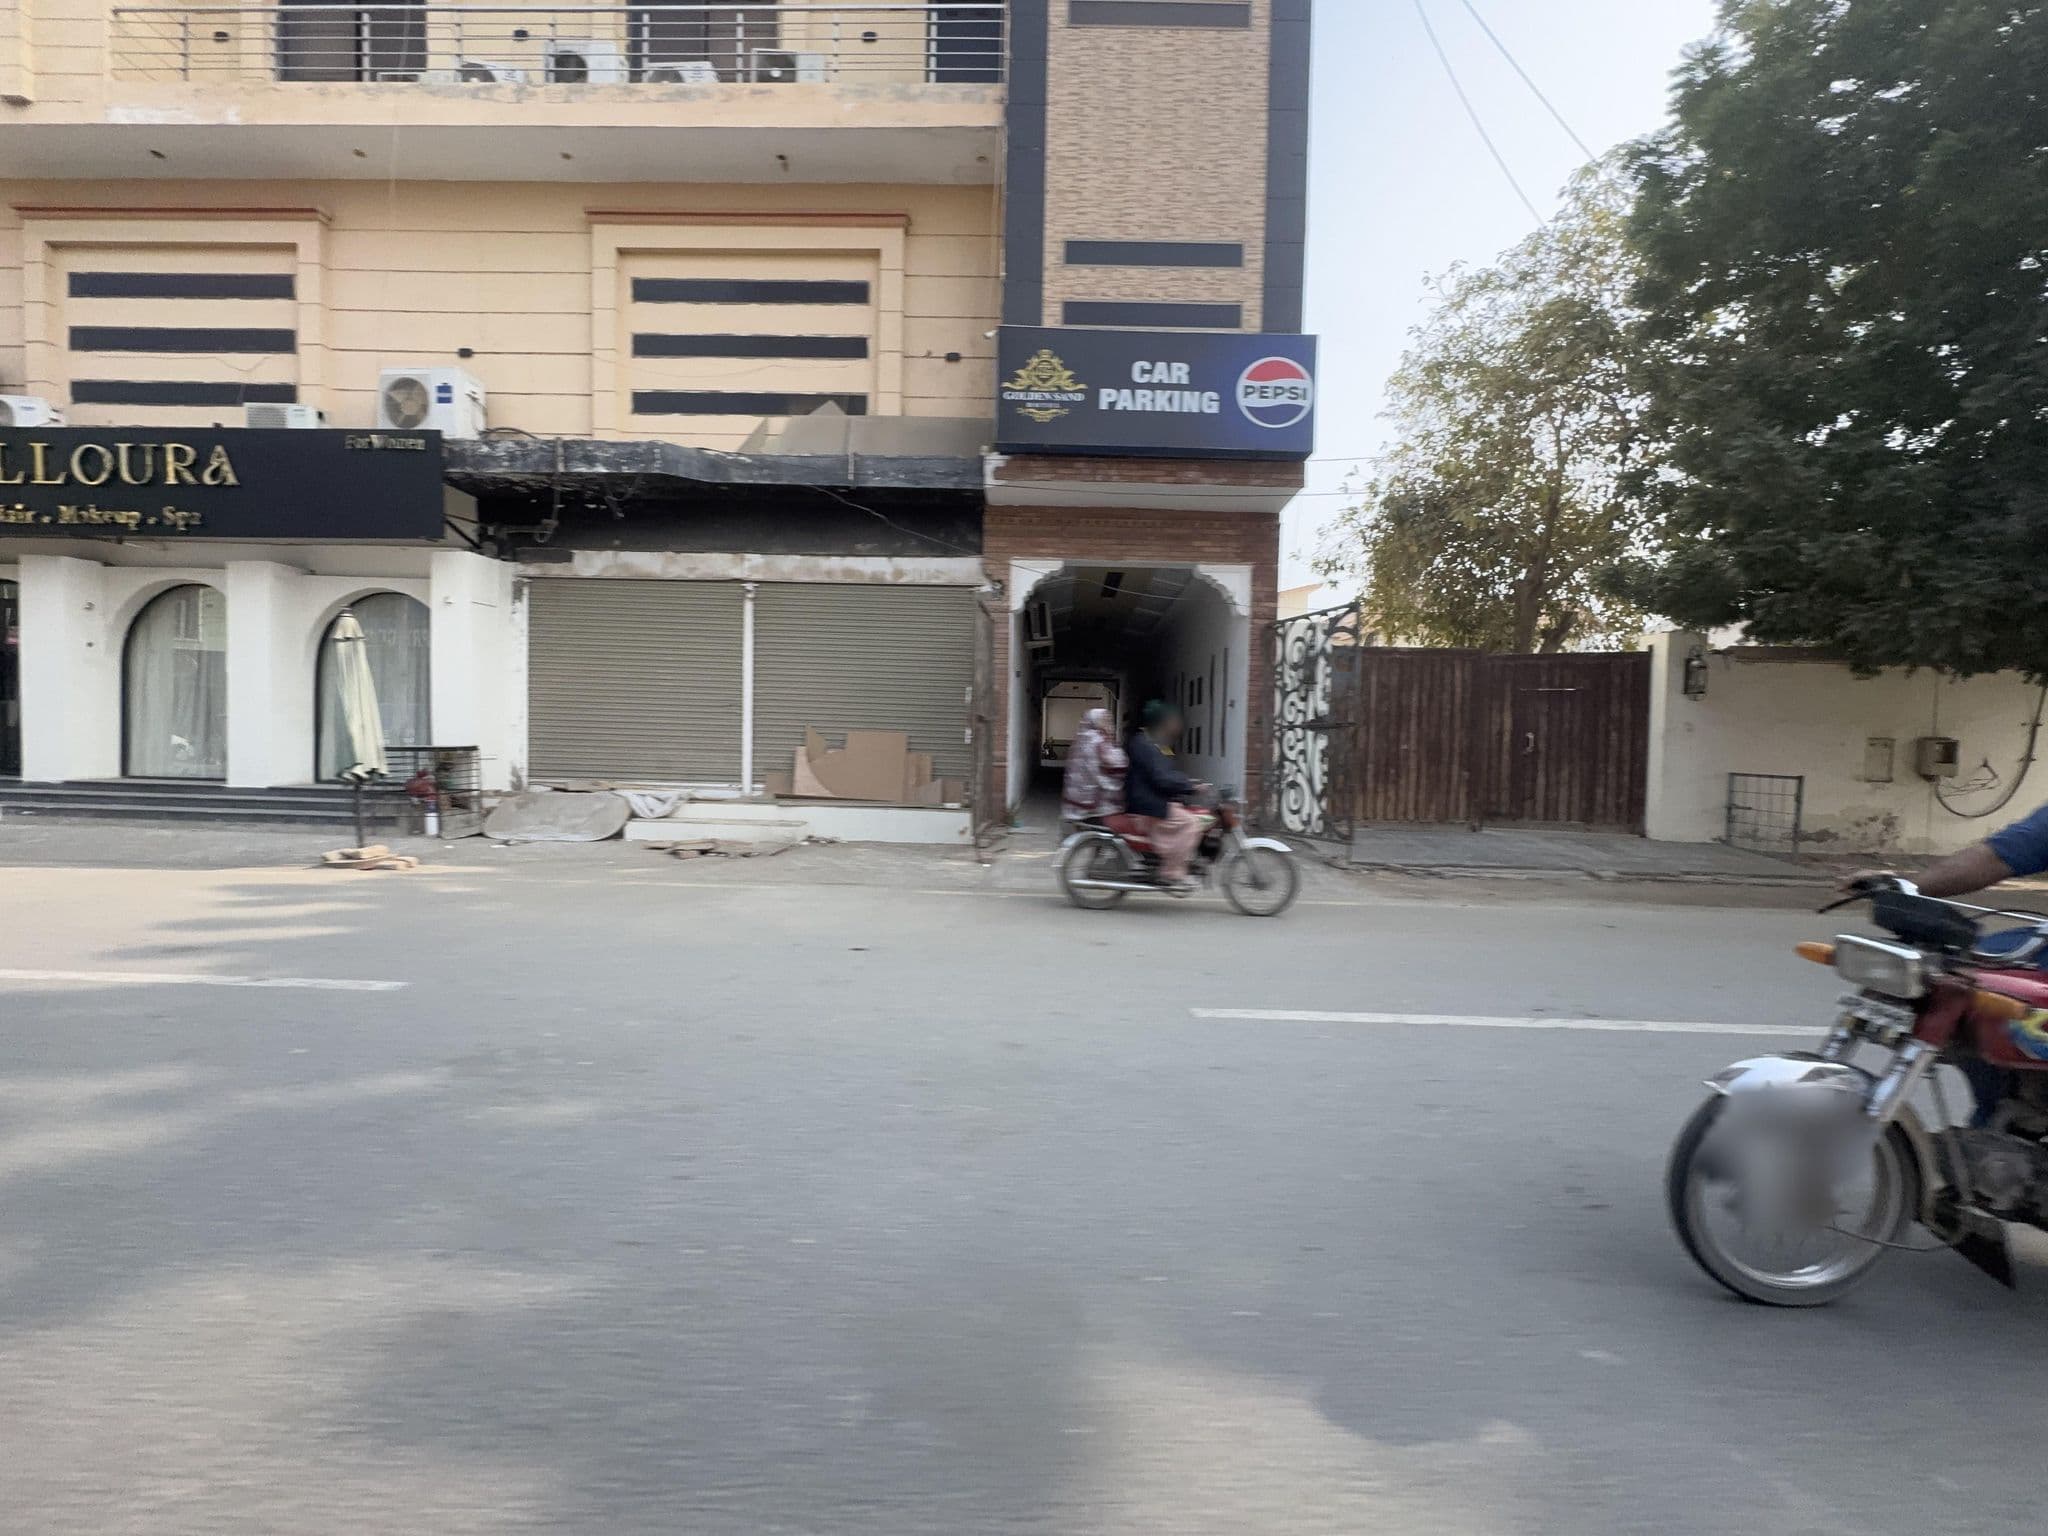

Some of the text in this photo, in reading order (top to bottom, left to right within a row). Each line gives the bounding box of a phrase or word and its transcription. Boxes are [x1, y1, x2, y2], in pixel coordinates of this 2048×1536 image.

[1131, 360, 1190, 385] CAR
[1098, 388, 1221, 414] PARKING
[1243, 385, 1308, 401] PEPSI
